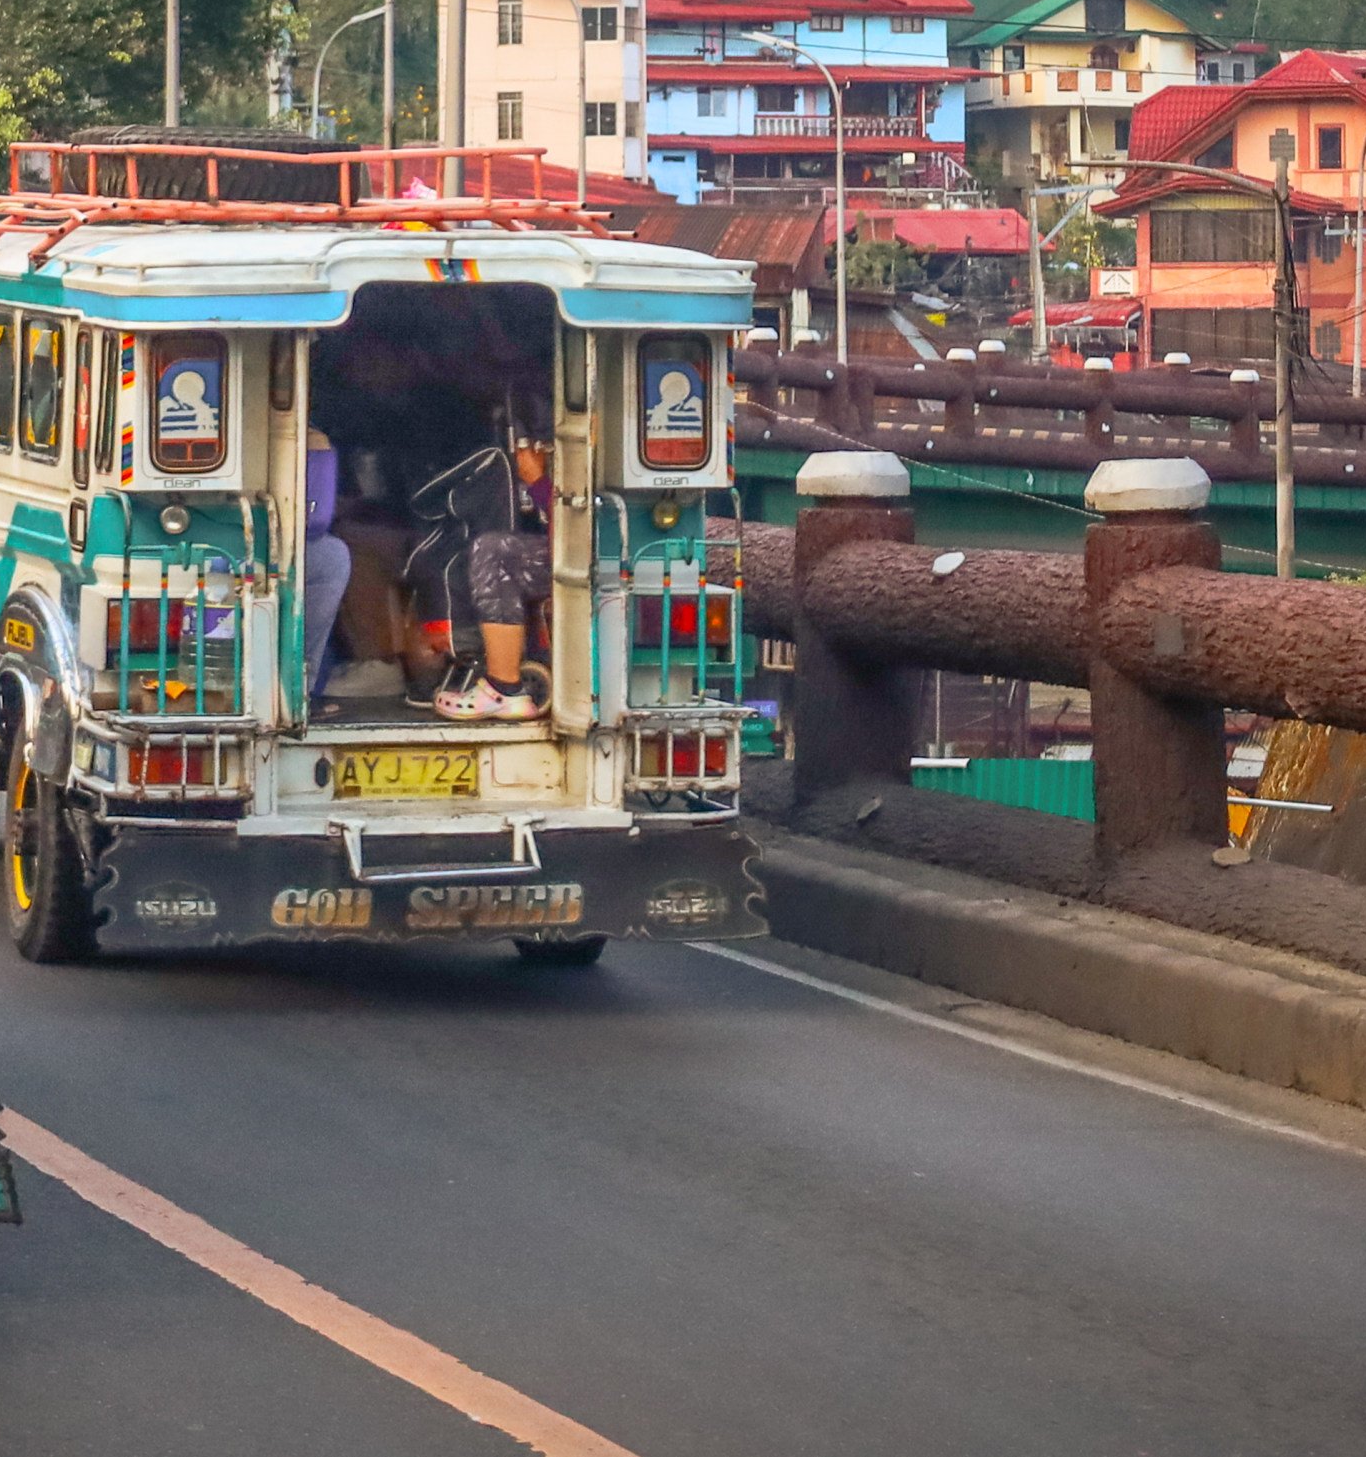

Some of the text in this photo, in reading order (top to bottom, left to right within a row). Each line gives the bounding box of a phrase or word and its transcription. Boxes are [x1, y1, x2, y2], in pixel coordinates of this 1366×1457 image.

[163, 478, 201, 489] clean
[653, 476, 689, 486] clean
[342, 755, 472, 784] AYJ 722
[136, 899, 217, 917] ISUZU
